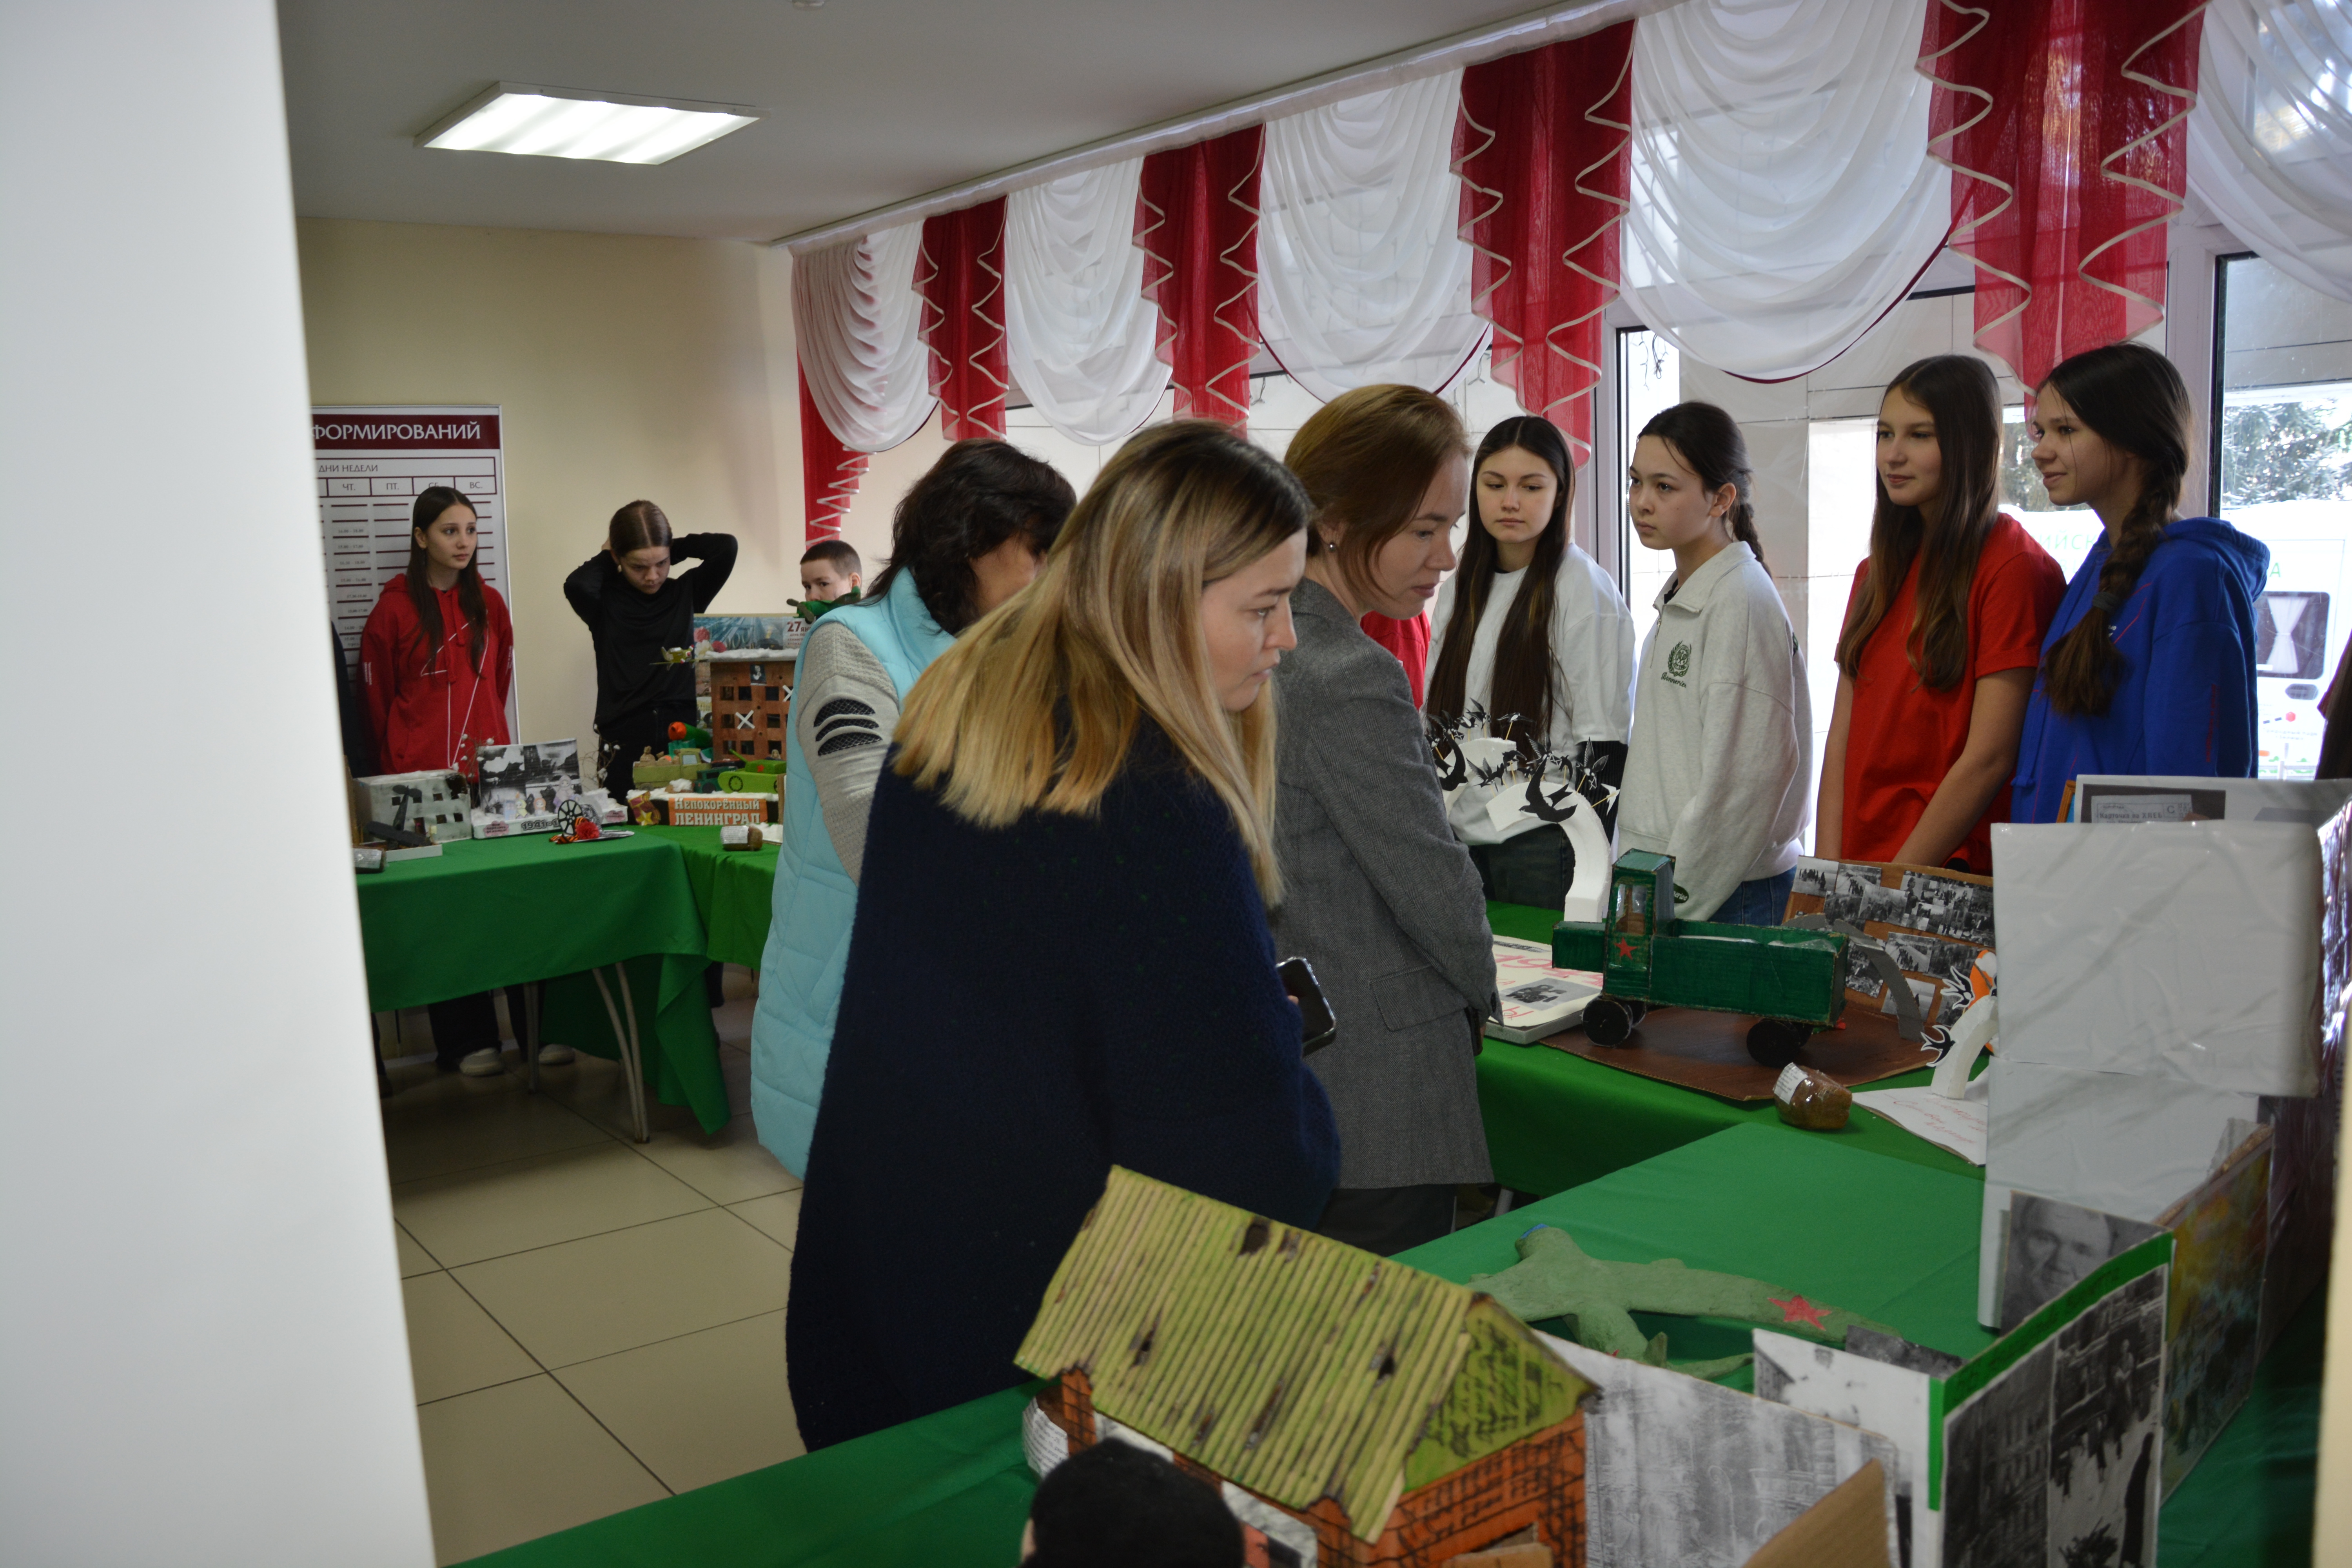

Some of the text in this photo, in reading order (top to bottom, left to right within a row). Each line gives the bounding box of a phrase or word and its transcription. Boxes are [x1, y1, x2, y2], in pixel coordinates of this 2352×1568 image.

[312, 421, 481, 440] ФОРМИРОВАНИЙ
[787, 621, 801, 632] 27
[675, 798, 760, 810] НЕПОКОРЁННЫЙ
